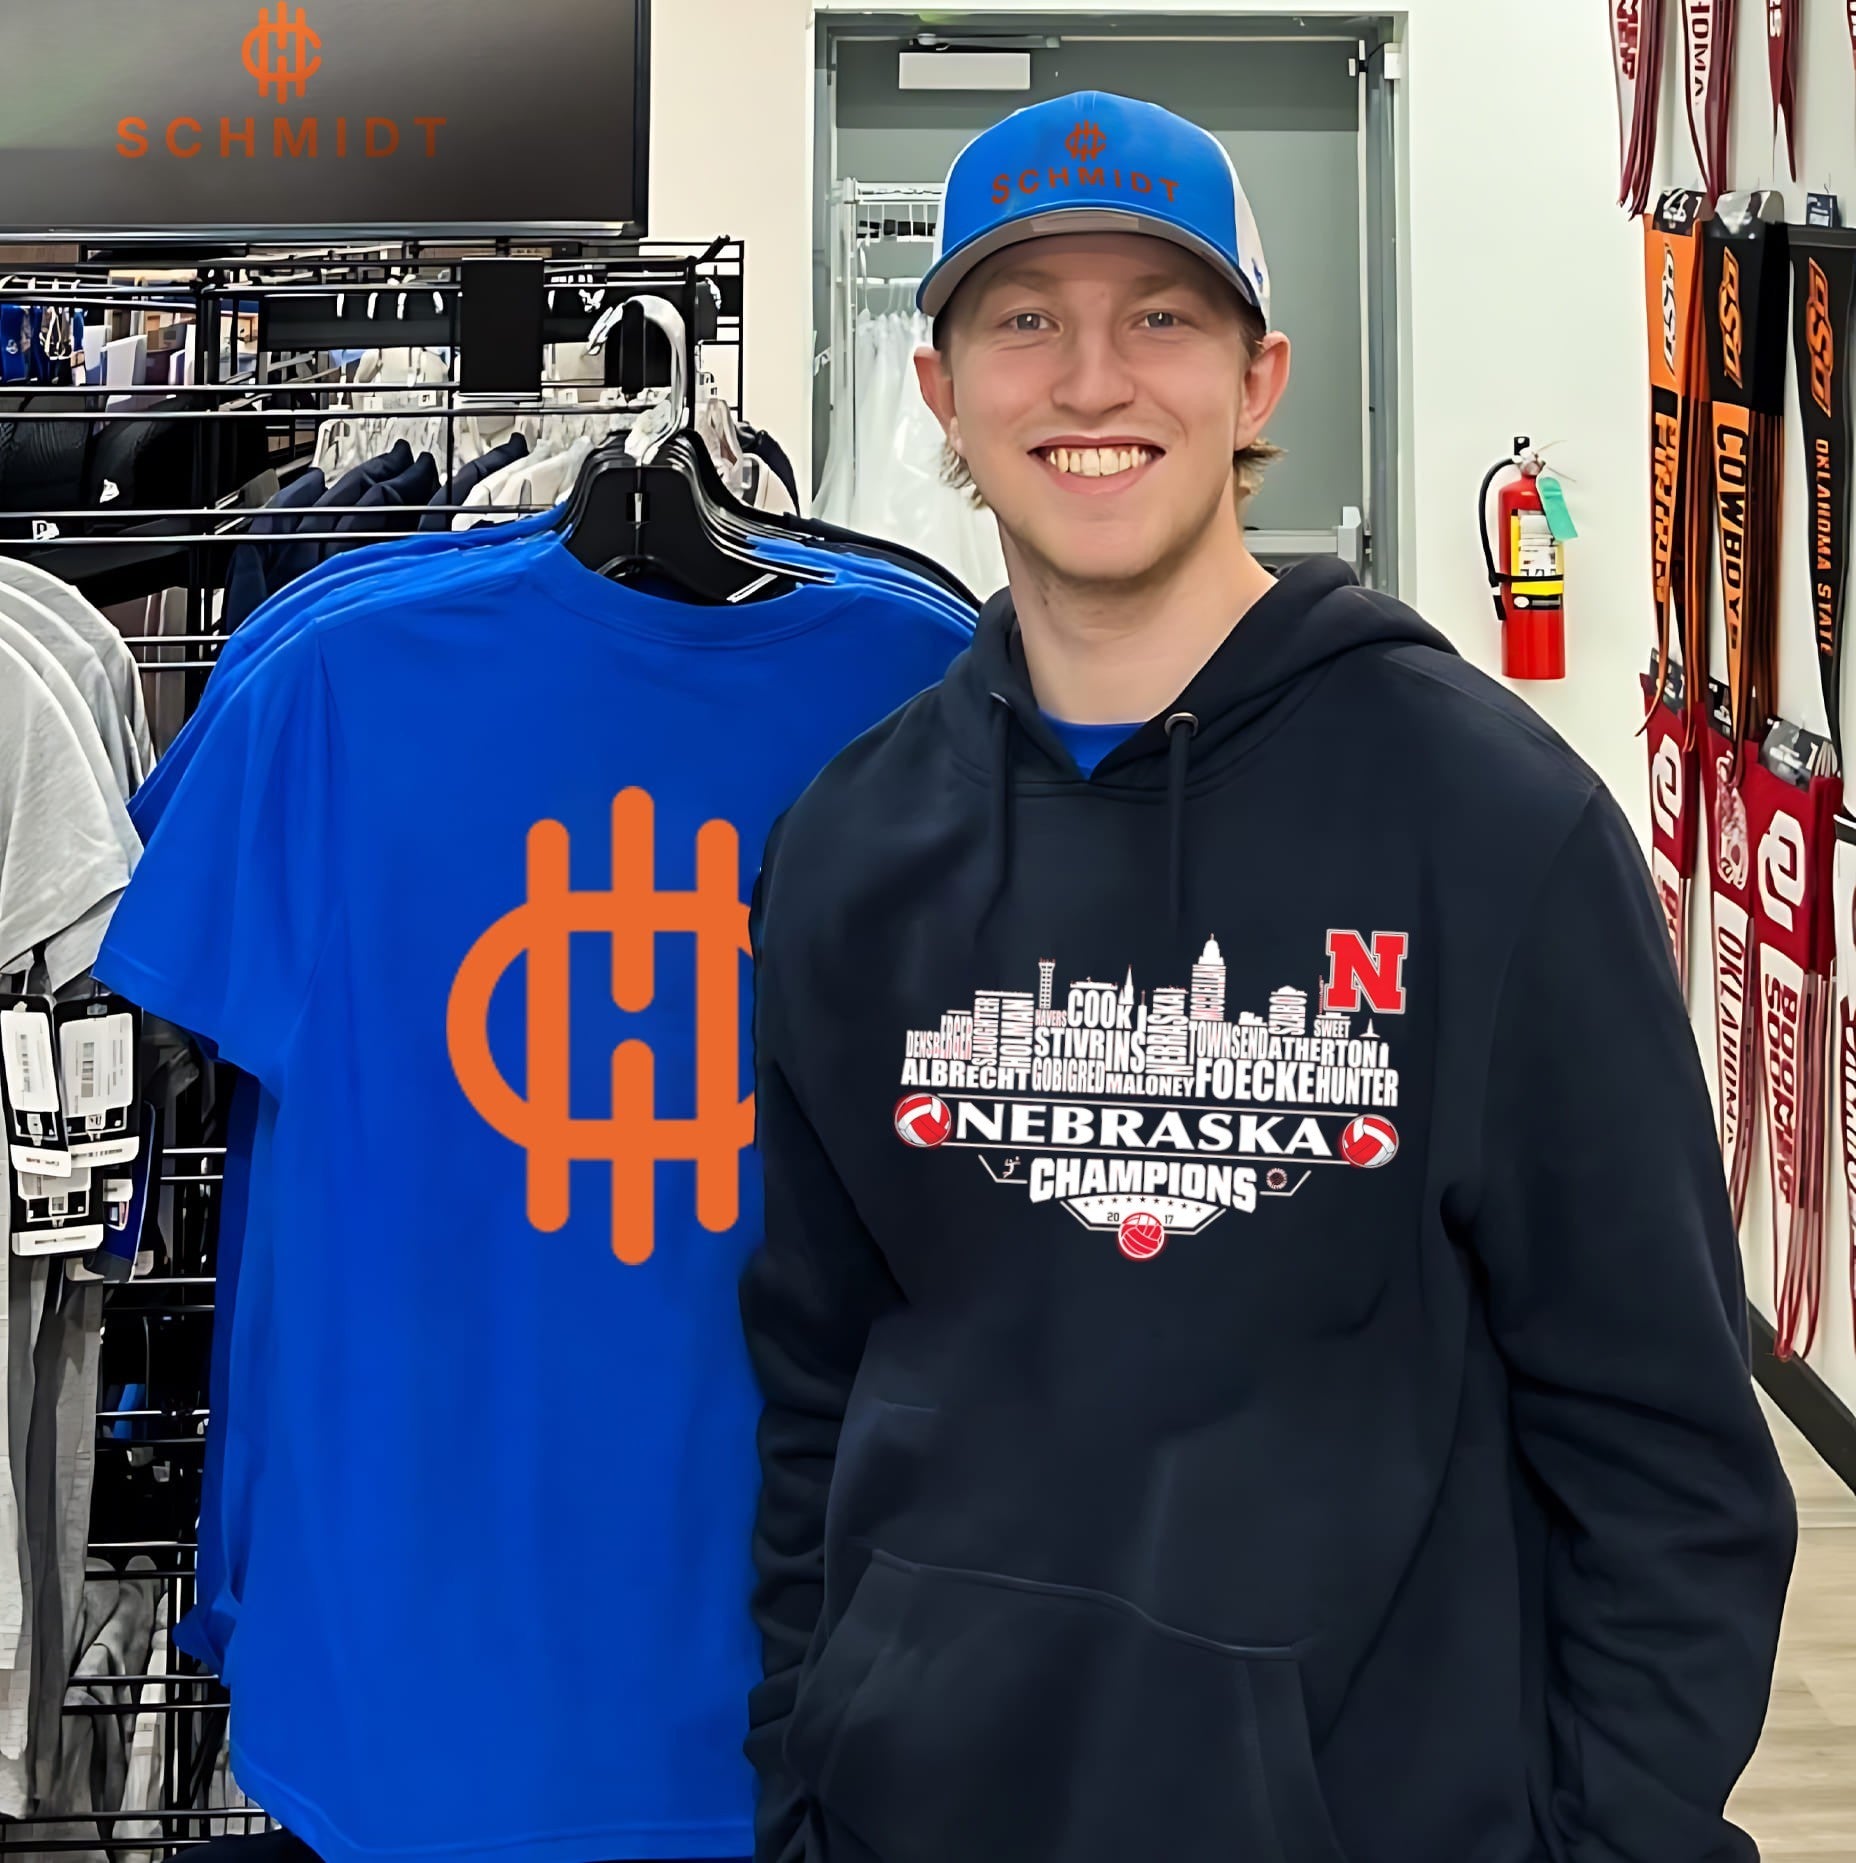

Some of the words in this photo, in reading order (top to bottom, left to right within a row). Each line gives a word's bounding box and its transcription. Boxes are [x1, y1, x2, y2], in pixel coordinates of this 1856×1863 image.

[115, 116, 448, 159] SCHMIDT
[991, 167, 1179, 205] SCHMIDT
[1815, 438, 1832, 571] OKLAHOMA
[1324, 929, 1409, 1015] N
[971, 997, 1000, 1067] SLAUGHTER
[1034, 1008, 1067, 1028] HAVERS
[1067, 989, 1133, 1030] COOK
[1268, 995, 1308, 1036] SZABO
[1313, 1018, 1351, 1039] SWEET
[905, 1014, 974, 1061] DENSBERGER
[999, 999, 1035, 1069] HOLMAN
[1034, 1026, 1147, 1074] STIVRINS
[1145, 992, 1194, 1077] NEBRASKA
[1189, 1021, 1269, 1065] TOWNSEND
[1267, 1036, 1379, 1069] ATHERTON
[900, 1058, 1032, 1091] ALBRECHT
[1105, 1072, 1195, 1097] MALONEY
[1194, 1057, 1316, 1104] FOECKE
[1315, 1066, 1399, 1107] HUNTER
[955, 1101, 1333, 1157] NEBRASKA
[1029, 1156, 1258, 1214] CHAMPIONS
[1107, 1211, 1120, 1222] 20
[1164, 1214, 1174, 1225] 17
